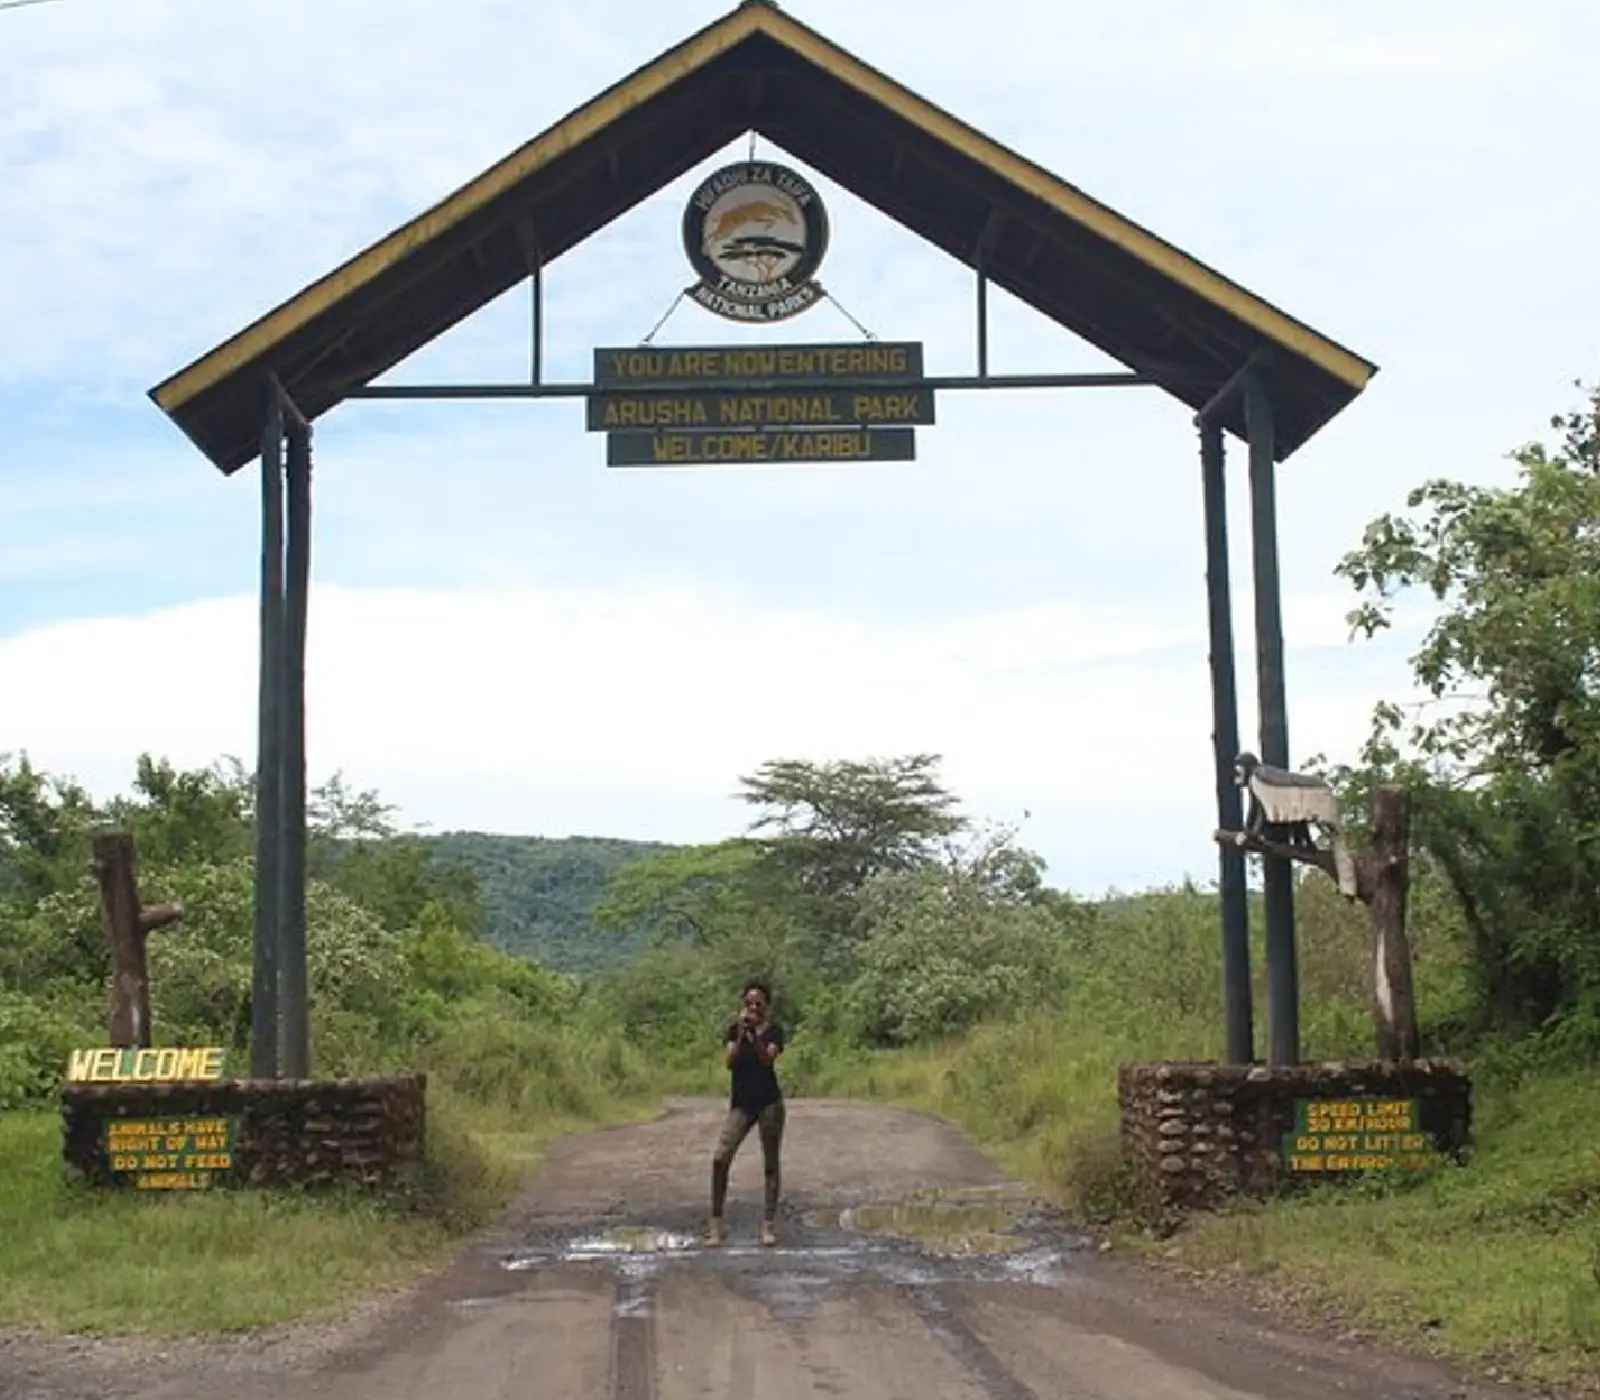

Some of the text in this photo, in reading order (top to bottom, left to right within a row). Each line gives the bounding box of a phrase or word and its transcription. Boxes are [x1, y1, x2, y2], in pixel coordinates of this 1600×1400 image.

[613, 349, 907, 377] YOU ARE NOW ENTERING
[604, 395, 921, 425] ARUSHA NATIONAL PARK
[653, 431, 871, 461] WELCOME/KARIBU
[68, 1048, 224, 1081] WELCOME
[1308, 1102, 1411, 1117] SPEED LIMIT
[108, 1120, 227, 1135] ANIMALS HAVE
[109, 1135, 226, 1151] RIGHT OF WAY
[1297, 1136, 1319, 1151] DO
[1323, 1135, 1358, 1150] NOT
[114, 1153, 231, 1169] DO NOT FEED
[1290, 1154, 1323, 1170] THE
